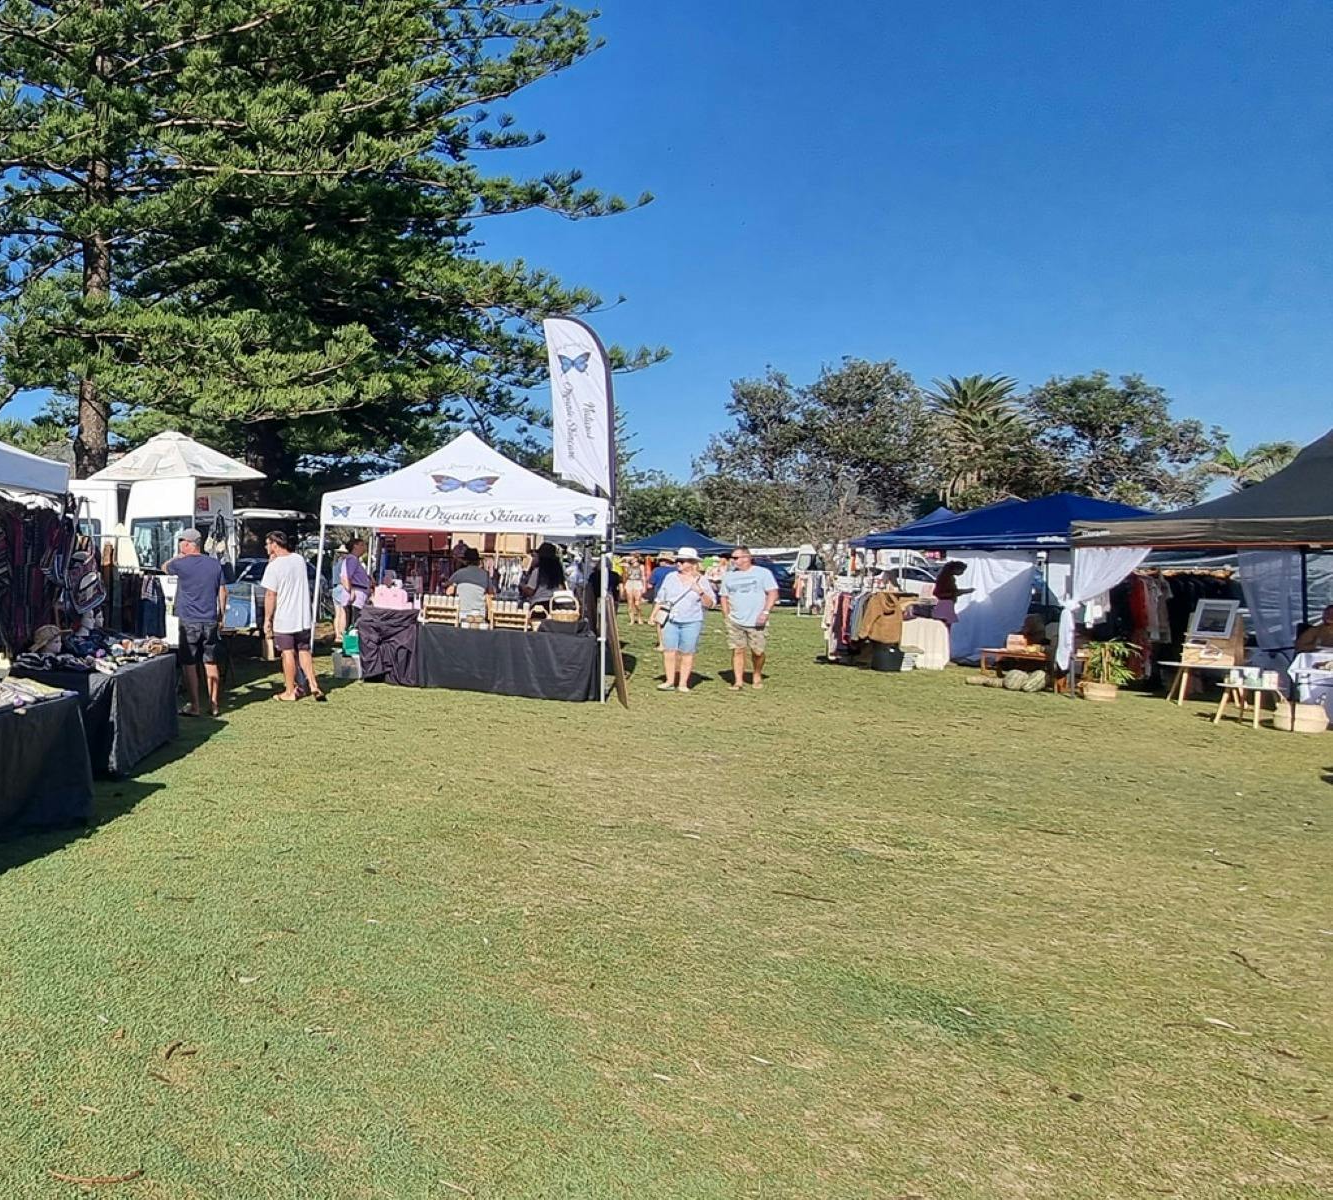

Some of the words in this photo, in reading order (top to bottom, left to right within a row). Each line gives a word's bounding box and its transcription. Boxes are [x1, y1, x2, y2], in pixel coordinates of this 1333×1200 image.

[582, 401, 595, 440] Natural
[368, 502, 423, 520] Natural
[425, 504, 480, 525] Organic
[484, 507, 550, 524] Skincare
